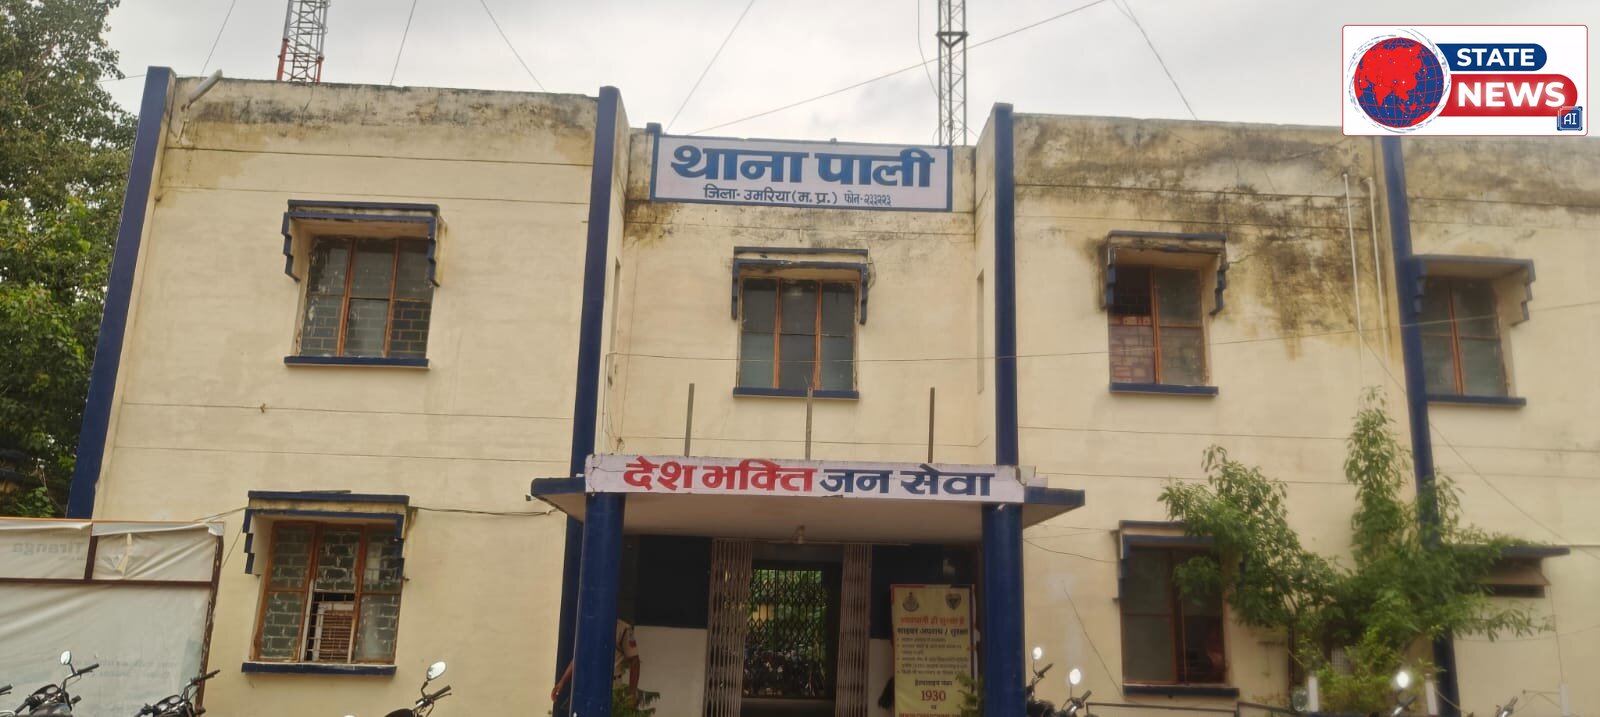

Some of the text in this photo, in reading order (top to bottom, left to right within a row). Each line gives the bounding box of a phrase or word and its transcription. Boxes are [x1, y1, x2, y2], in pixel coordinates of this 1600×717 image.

[671, 145, 935, 187] थाना पाली
[623, 456, 995, 497] देश भक्ति जन सेवा
[921, 690, 946, 702] 1930
